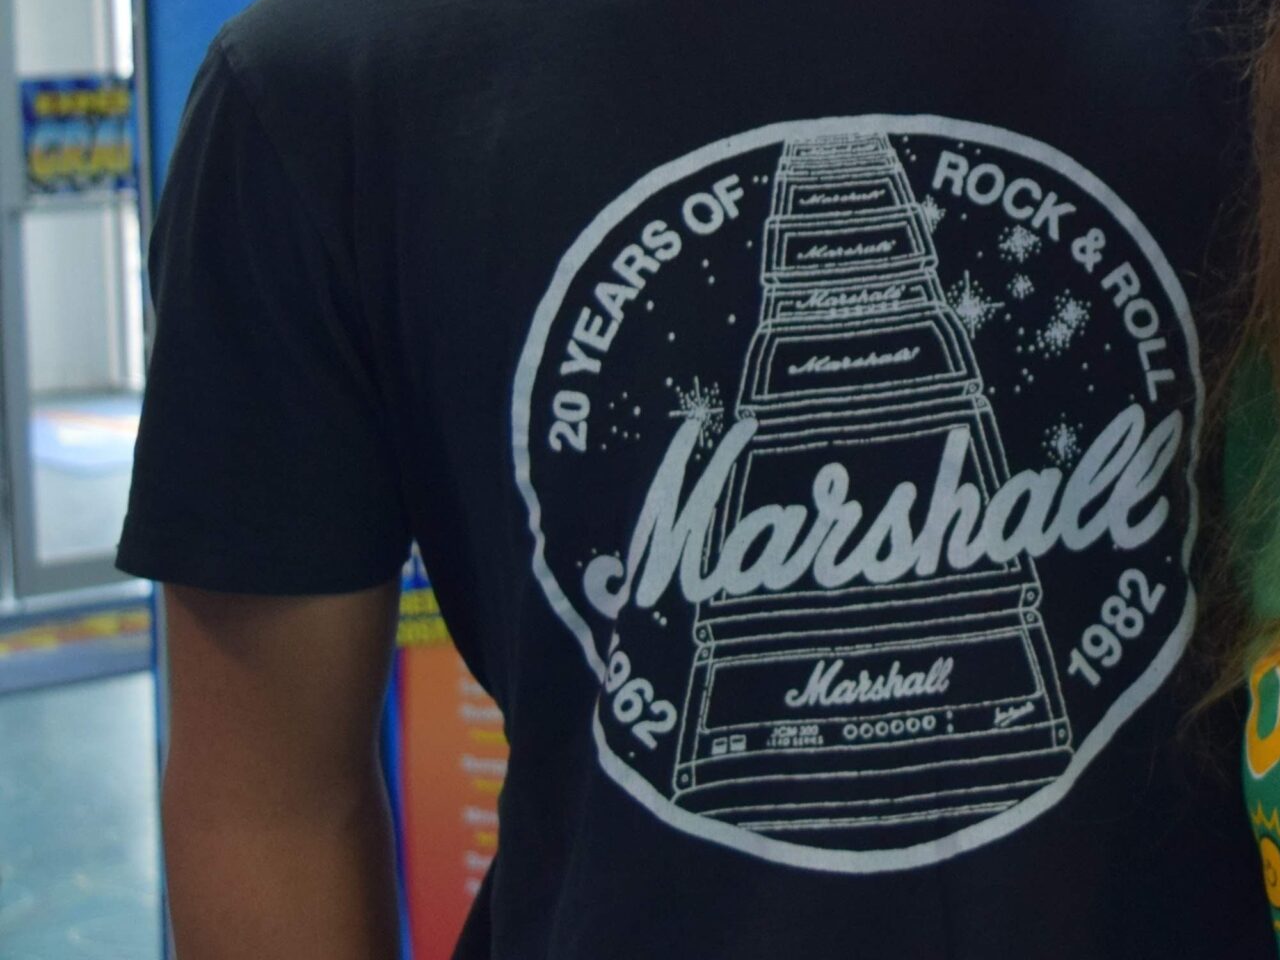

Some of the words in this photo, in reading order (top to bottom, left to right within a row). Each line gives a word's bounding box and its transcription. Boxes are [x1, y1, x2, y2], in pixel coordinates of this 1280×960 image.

[681, 173, 746, 236] OF
[558, 218, 684, 377] YEARS
[931, 150, 1078, 243] ROCK
[1070, 227, 1107, 273] &
[1100, 261, 1176, 403] ROLL
[548, 389, 591, 453] 20
[583, 403, 1184, 620] Marshall
[785, 657, 954, 708] Marshall
[1066, 568, 1166, 687] 1982
